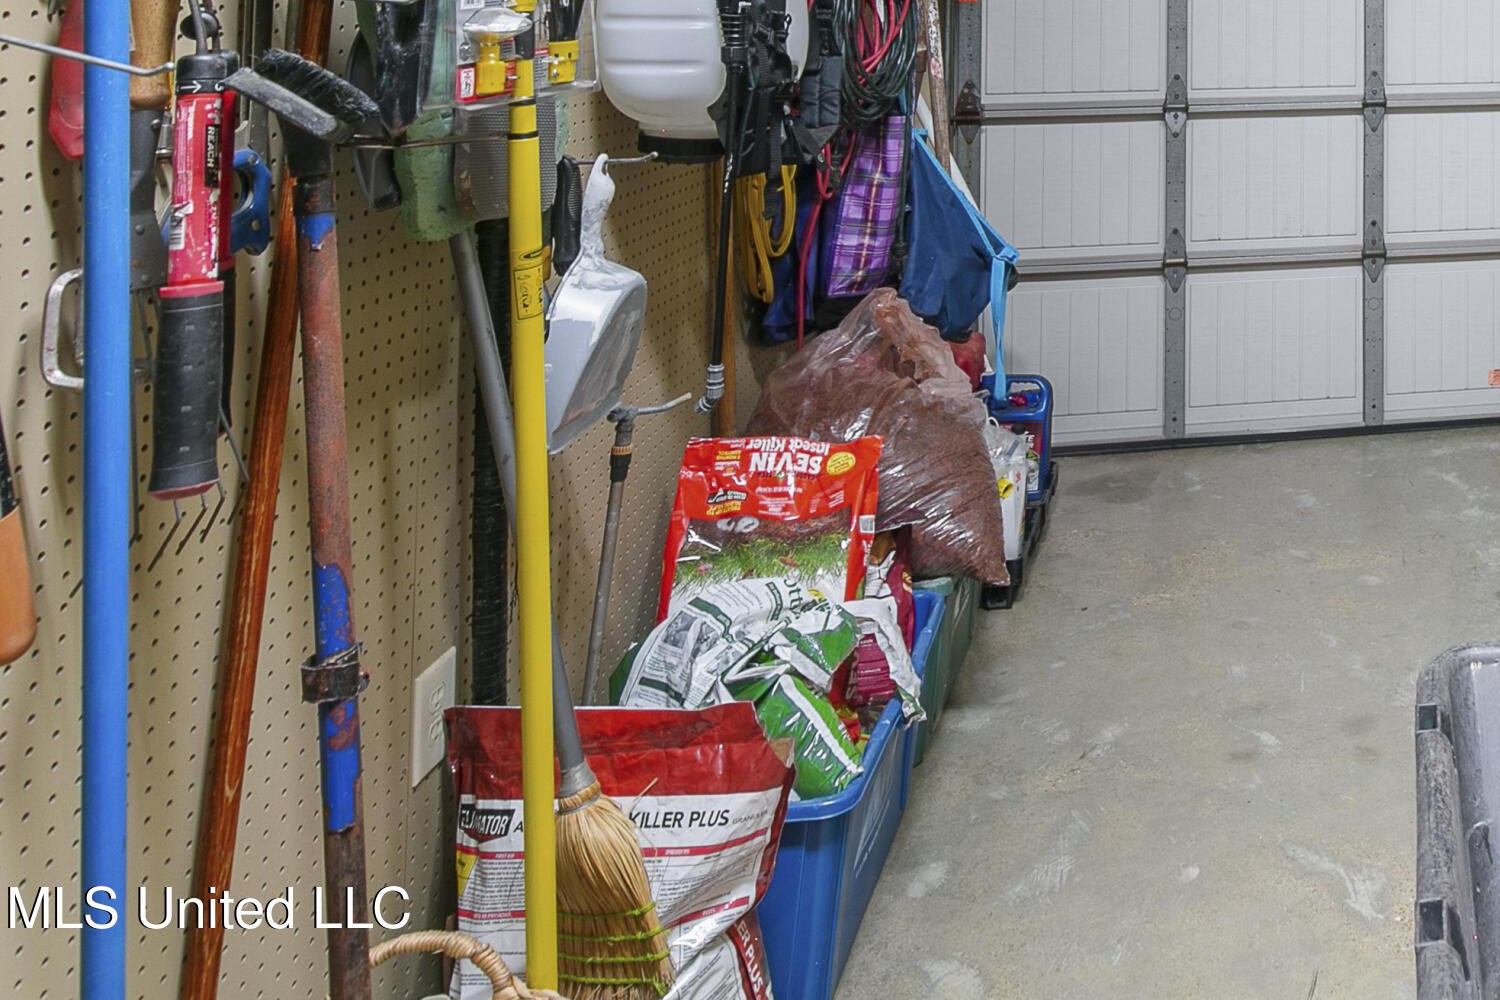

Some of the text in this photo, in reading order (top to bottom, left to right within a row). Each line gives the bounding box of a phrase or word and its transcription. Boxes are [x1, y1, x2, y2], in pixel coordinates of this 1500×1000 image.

[206, 126, 215, 168] REACH
[746, 436, 831, 457] Insect Killer
[750, 451, 824, 475] SEVIN
[629, 810, 682, 829] KILLER
[688, 809, 730, 828] PLUS
[744, 944, 764, 993] PLUS
